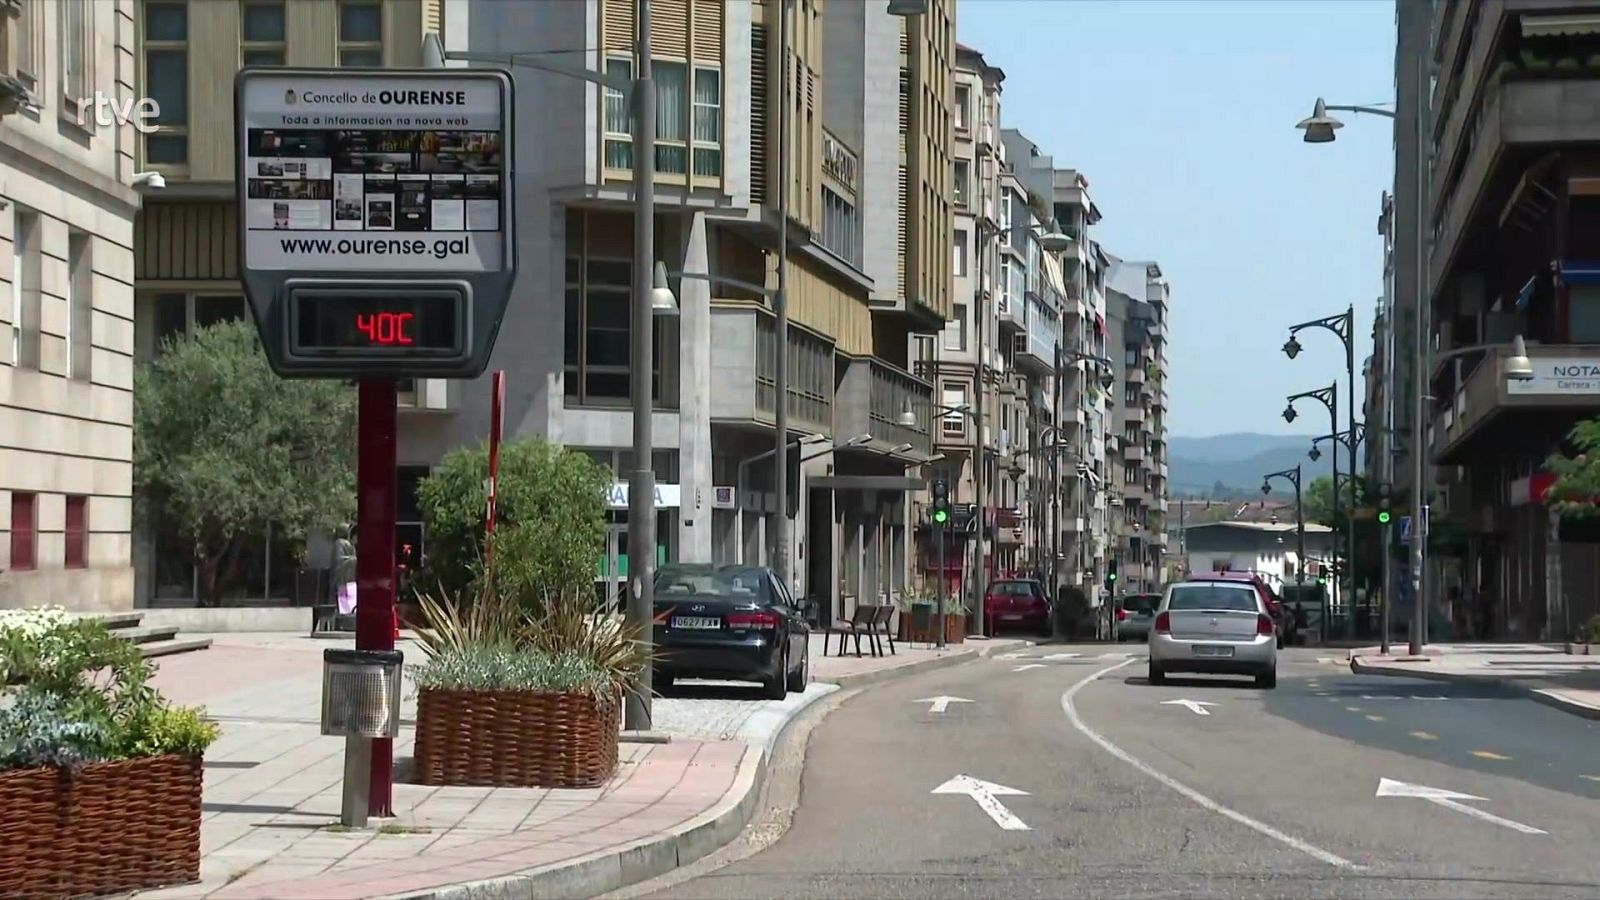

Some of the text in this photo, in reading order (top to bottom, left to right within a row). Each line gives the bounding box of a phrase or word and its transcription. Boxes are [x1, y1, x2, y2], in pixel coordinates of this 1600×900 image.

[303, 90, 466, 105] Concello de OURENSE
[282, 115, 309, 125] Toda
[313, 116, 320, 125] a
[396, 117, 411, 126] na
[415, 117, 442, 126] nova
[446, 116, 469, 126] web
[281, 236, 469, 259] www.ourense.gal
[1554, 366, 1600, 376] NOTA
